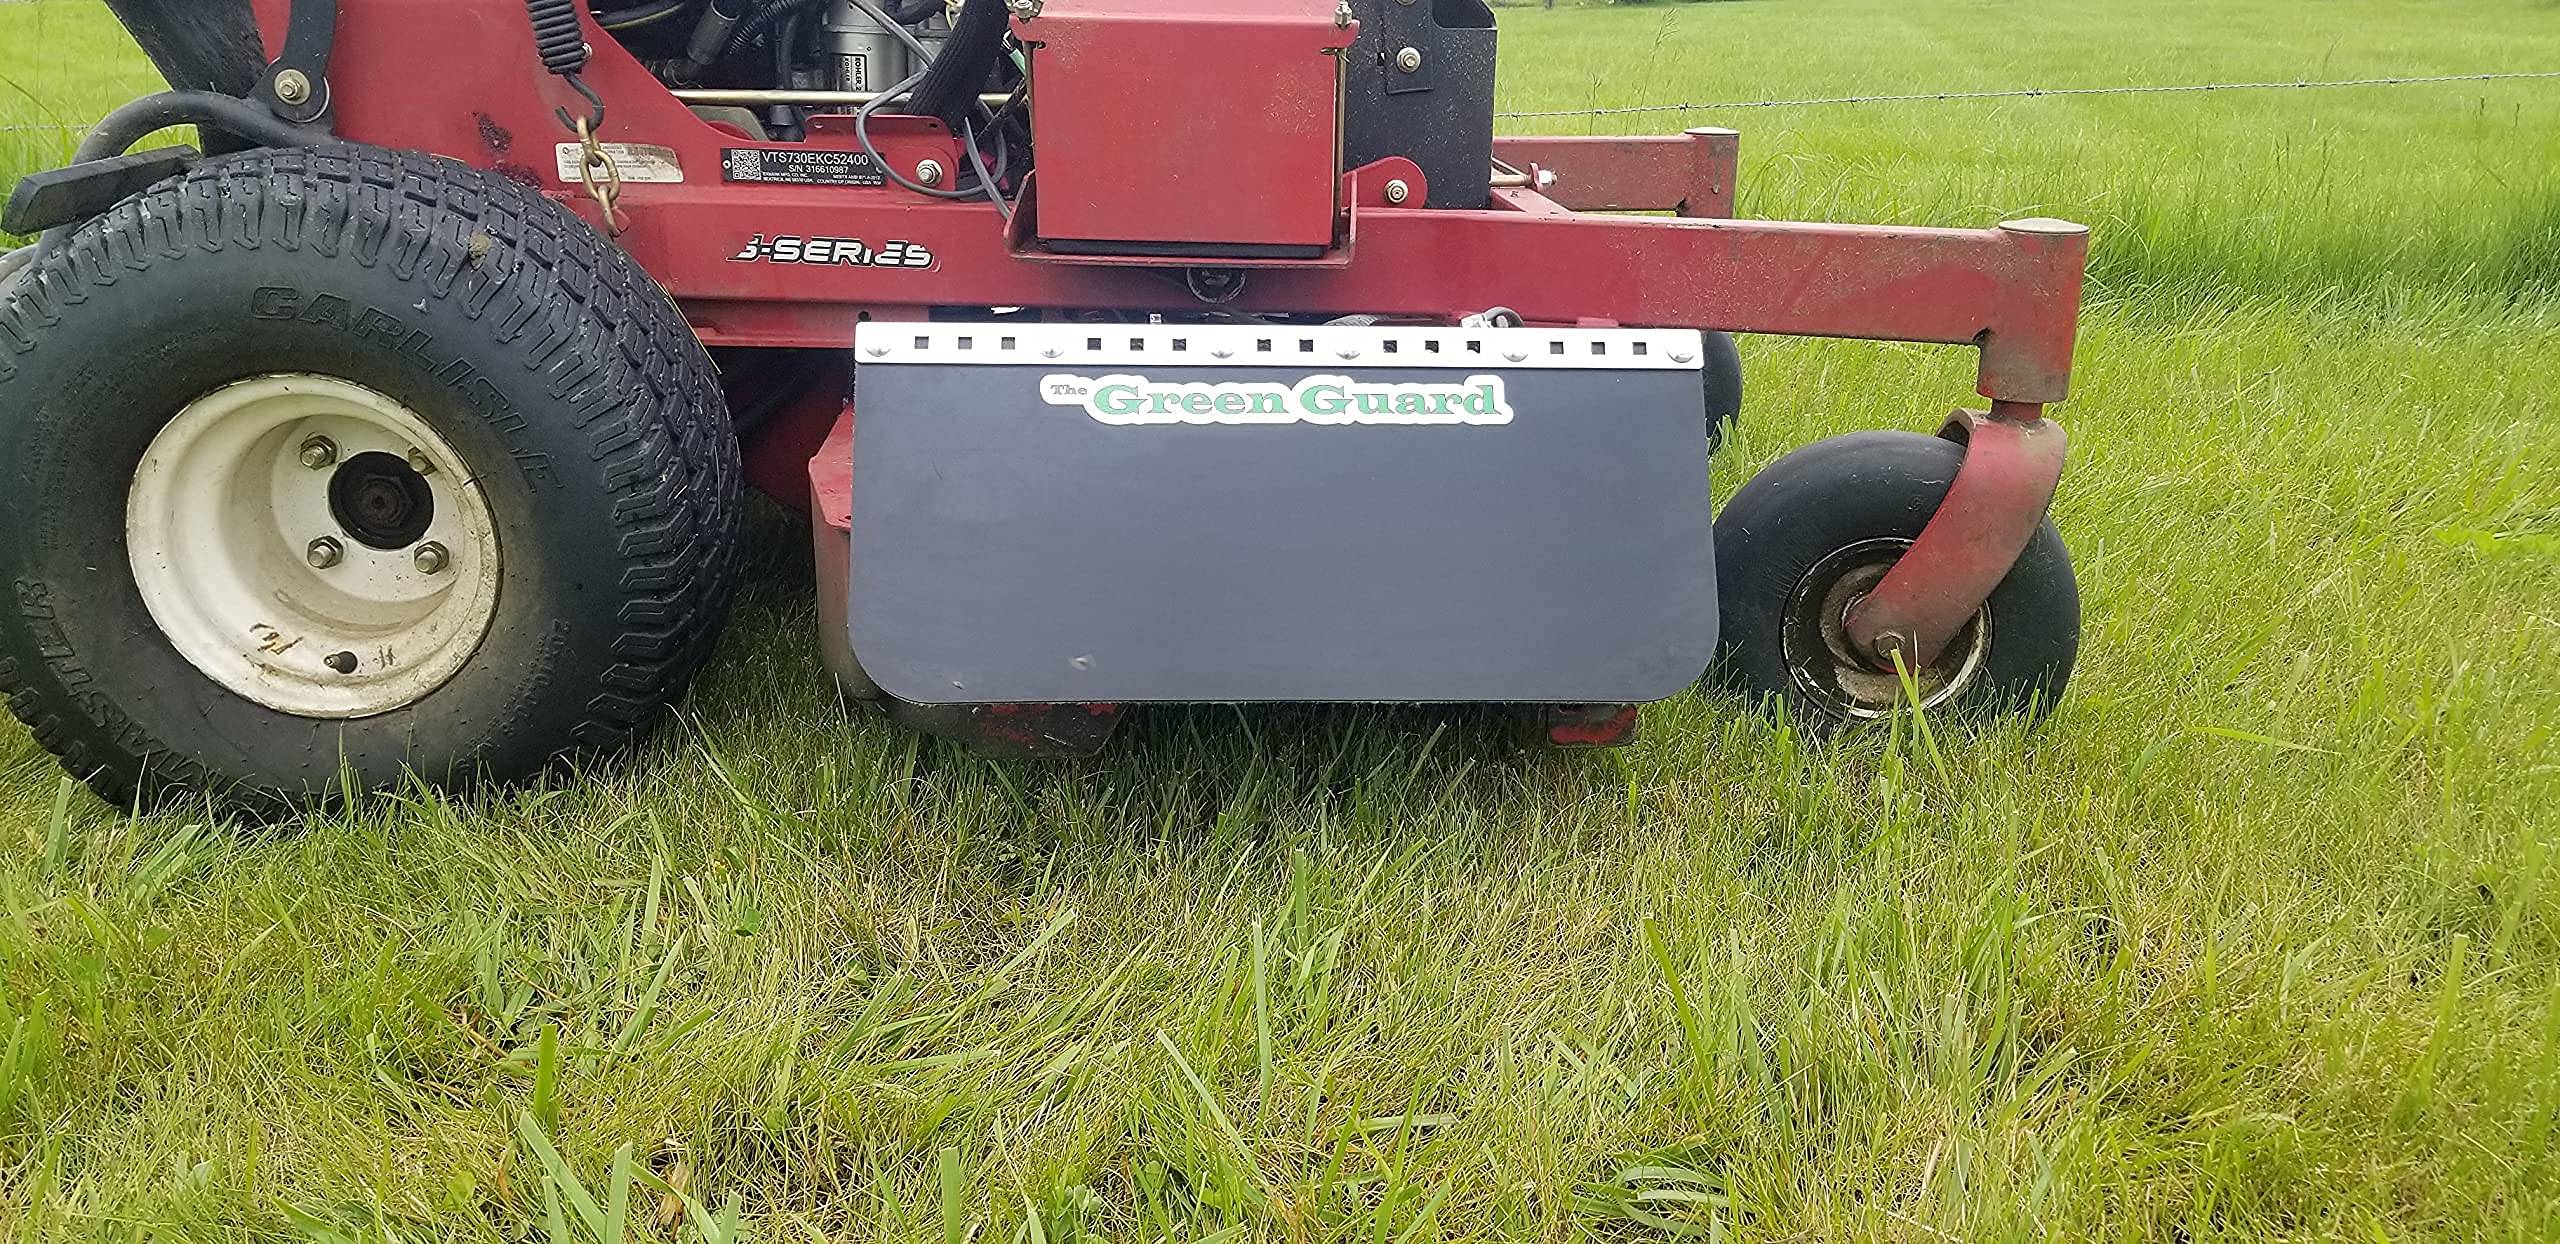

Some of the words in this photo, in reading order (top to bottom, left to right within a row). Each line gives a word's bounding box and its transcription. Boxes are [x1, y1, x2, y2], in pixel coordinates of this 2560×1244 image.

[854, 57, 862, 85] KOHLER
[761, 151, 869, 166] VTS730EKC52400
[788, 164, 803, 173] S/N
[806, 165, 849, 175] 316610987
[250, 285, 565, 496] CARLISLE
[1050, 385, 1088, 395] The
[1093, 384, 1290, 416] Green
[1299, 384, 1503, 416] Guard
